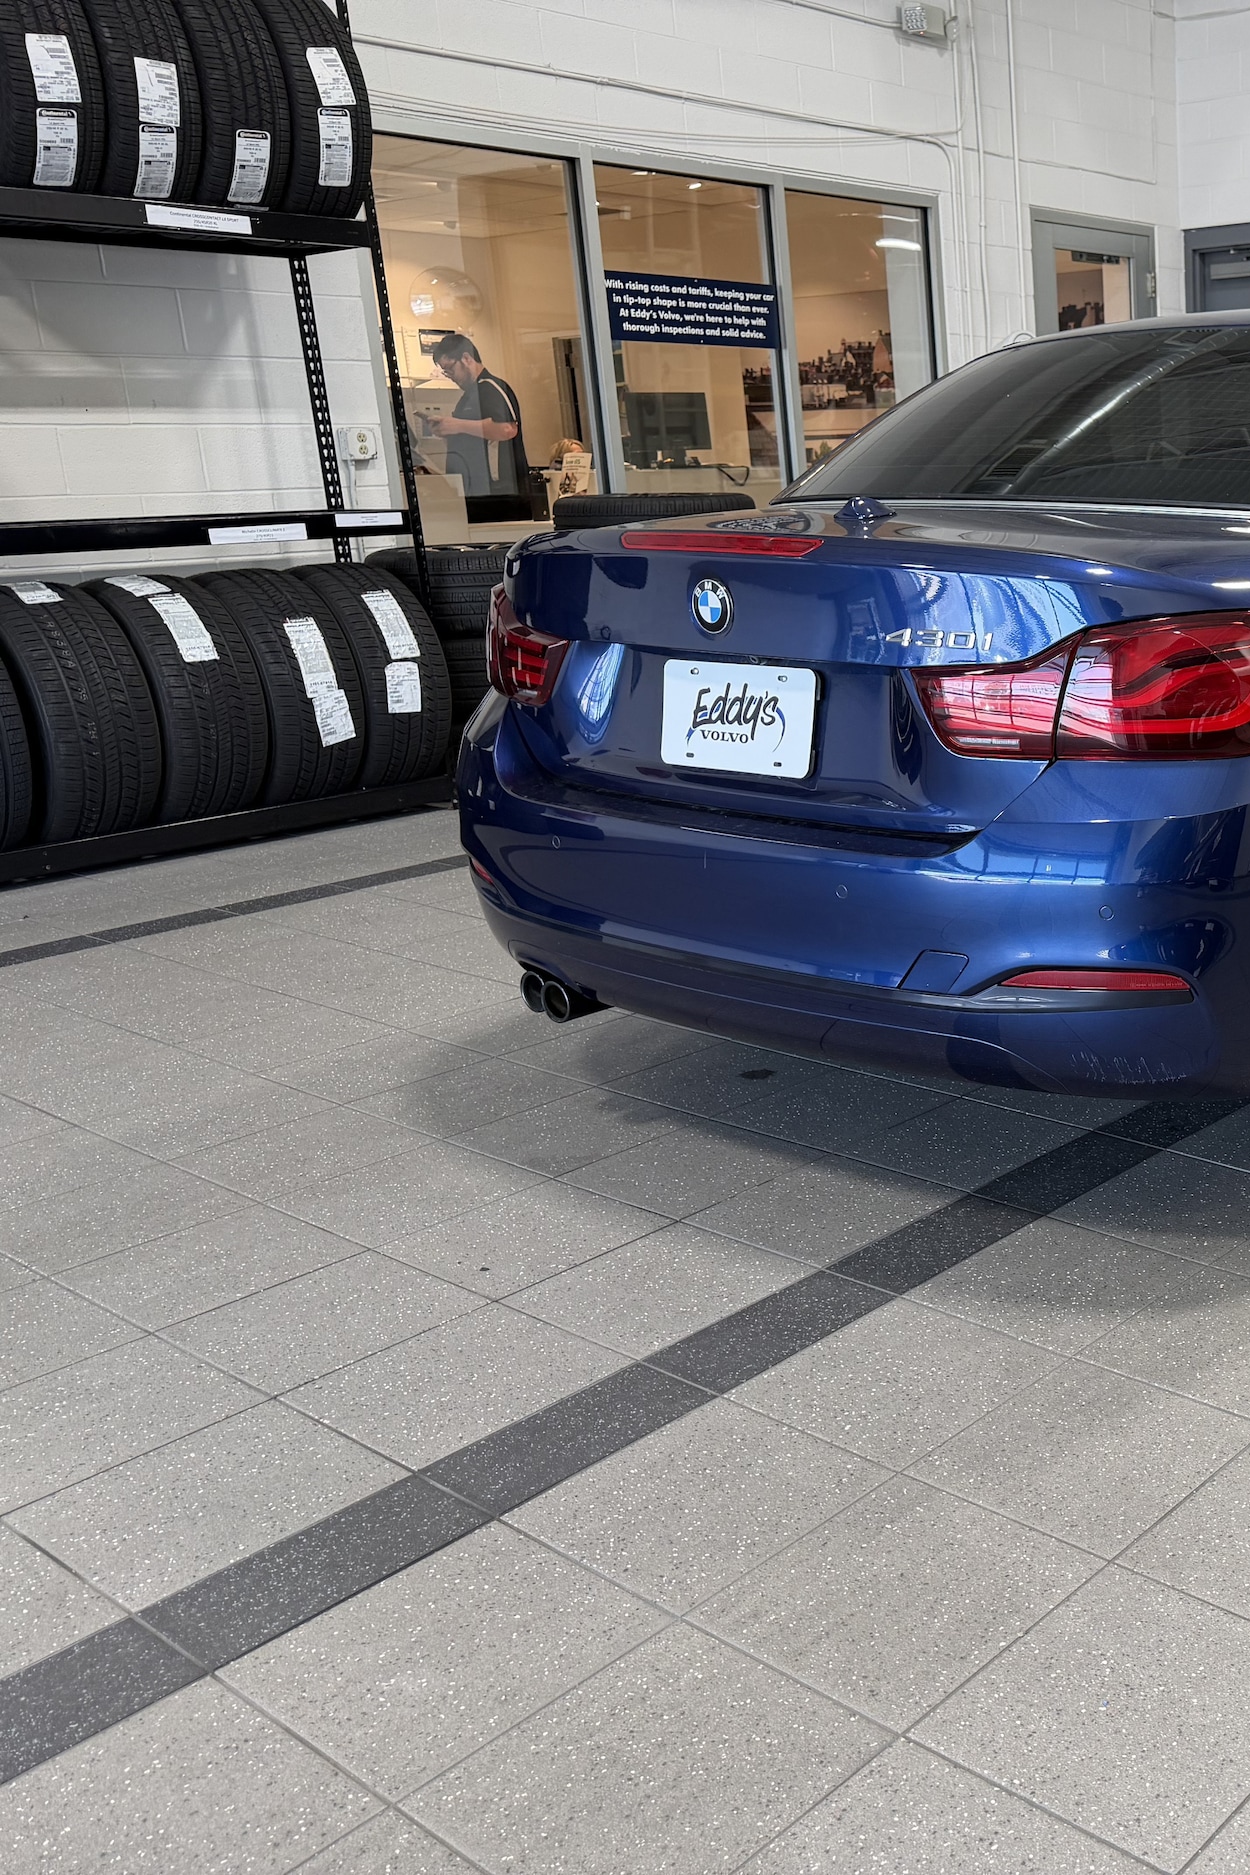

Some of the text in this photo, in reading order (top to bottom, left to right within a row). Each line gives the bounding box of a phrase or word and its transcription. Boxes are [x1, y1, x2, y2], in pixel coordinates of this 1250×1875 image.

[604, 279, 624, 289] With
[625, 281, 649, 293] rising
[650, 284, 670, 293] costs
[671, 285, 687, 294] and
[688, 287, 713, 297] tariffs,
[714, 288, 744, 301] keeping
[745, 293, 762, 301] your
[613, 293, 769, 314] in tip-top shape is more crucial than ever.
[619, 308, 767, 327] At Eddy's Volvo, we're here to help with
[623, 321, 766, 339] thorough inspections and solid advice.
[694, 581, 725, 599] BMW
[692, 682, 779, 740] Eddy's
[700, 729, 749, 743] VOLVO
